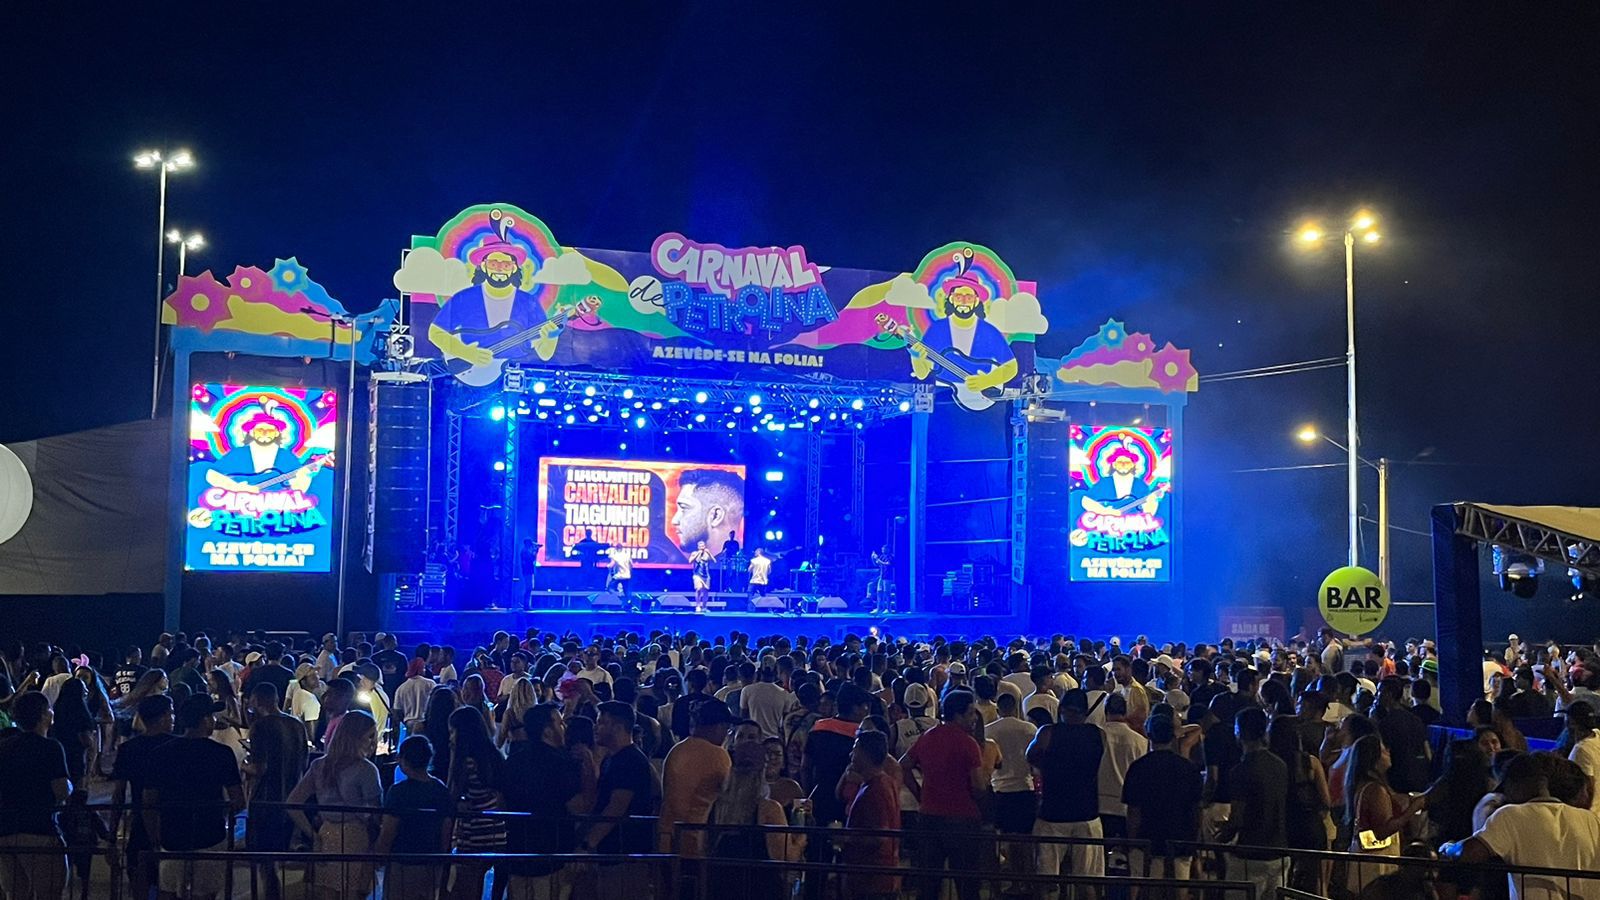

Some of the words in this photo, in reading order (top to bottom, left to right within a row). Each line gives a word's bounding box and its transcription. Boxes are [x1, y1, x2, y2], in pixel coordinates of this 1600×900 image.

[656, 238, 816, 298] CARNAVAL
[629, 280, 666, 306] de
[662, 283, 837, 332] PETROLINA
[748, 351, 771, 364] NA
[774, 353, 824, 368] FOLIA!
[564, 482, 651, 505] CARVALHO
[211, 508, 328, 536] PETROLINA
[563, 503, 650, 526] TIAGUINHO
[1326, 586, 1383, 609] BAR
